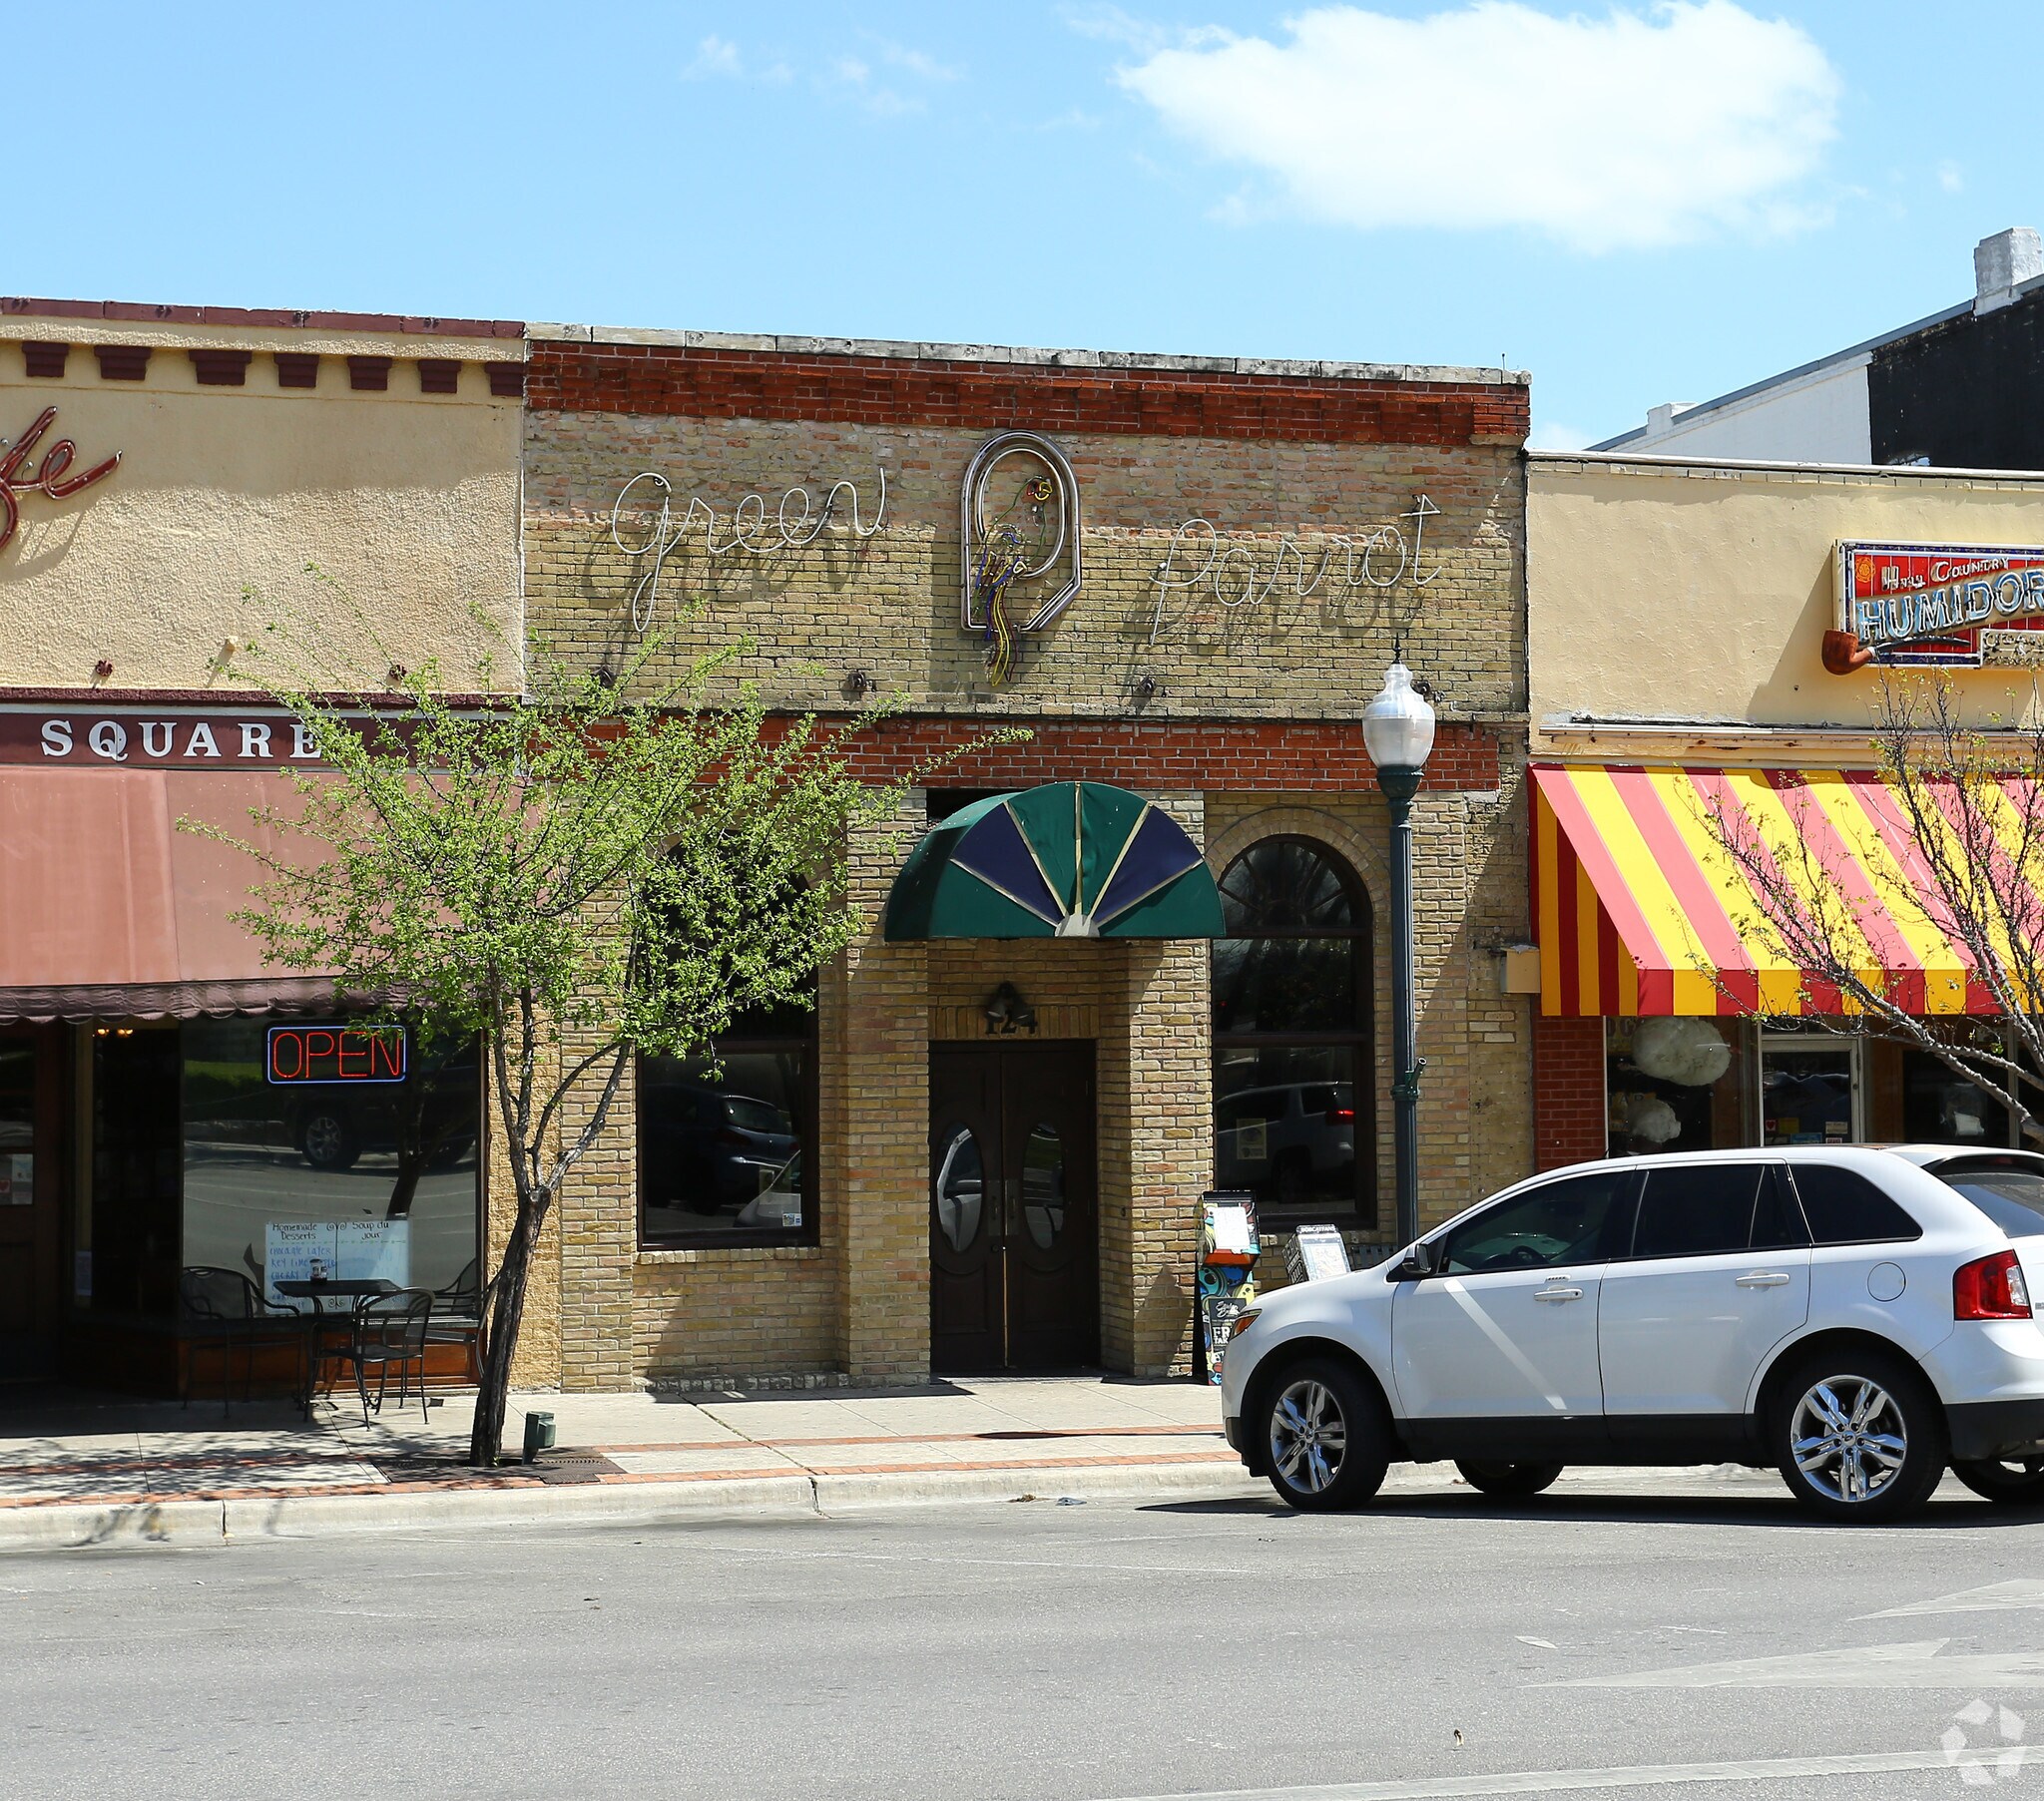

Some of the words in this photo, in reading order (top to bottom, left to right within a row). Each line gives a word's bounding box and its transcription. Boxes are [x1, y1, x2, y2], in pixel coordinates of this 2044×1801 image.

[1856, 568, 2044, 643] HUMIDOR
[41, 719, 322, 762] SQUARE
[273, 1032, 401, 1079] OPEN
[272, 1223, 317, 1232] Homemade
[352, 1221, 375, 1231] Soup
[280, 1231, 316, 1240] Desserts
[1213, 1326, 1232, 1339] FR
